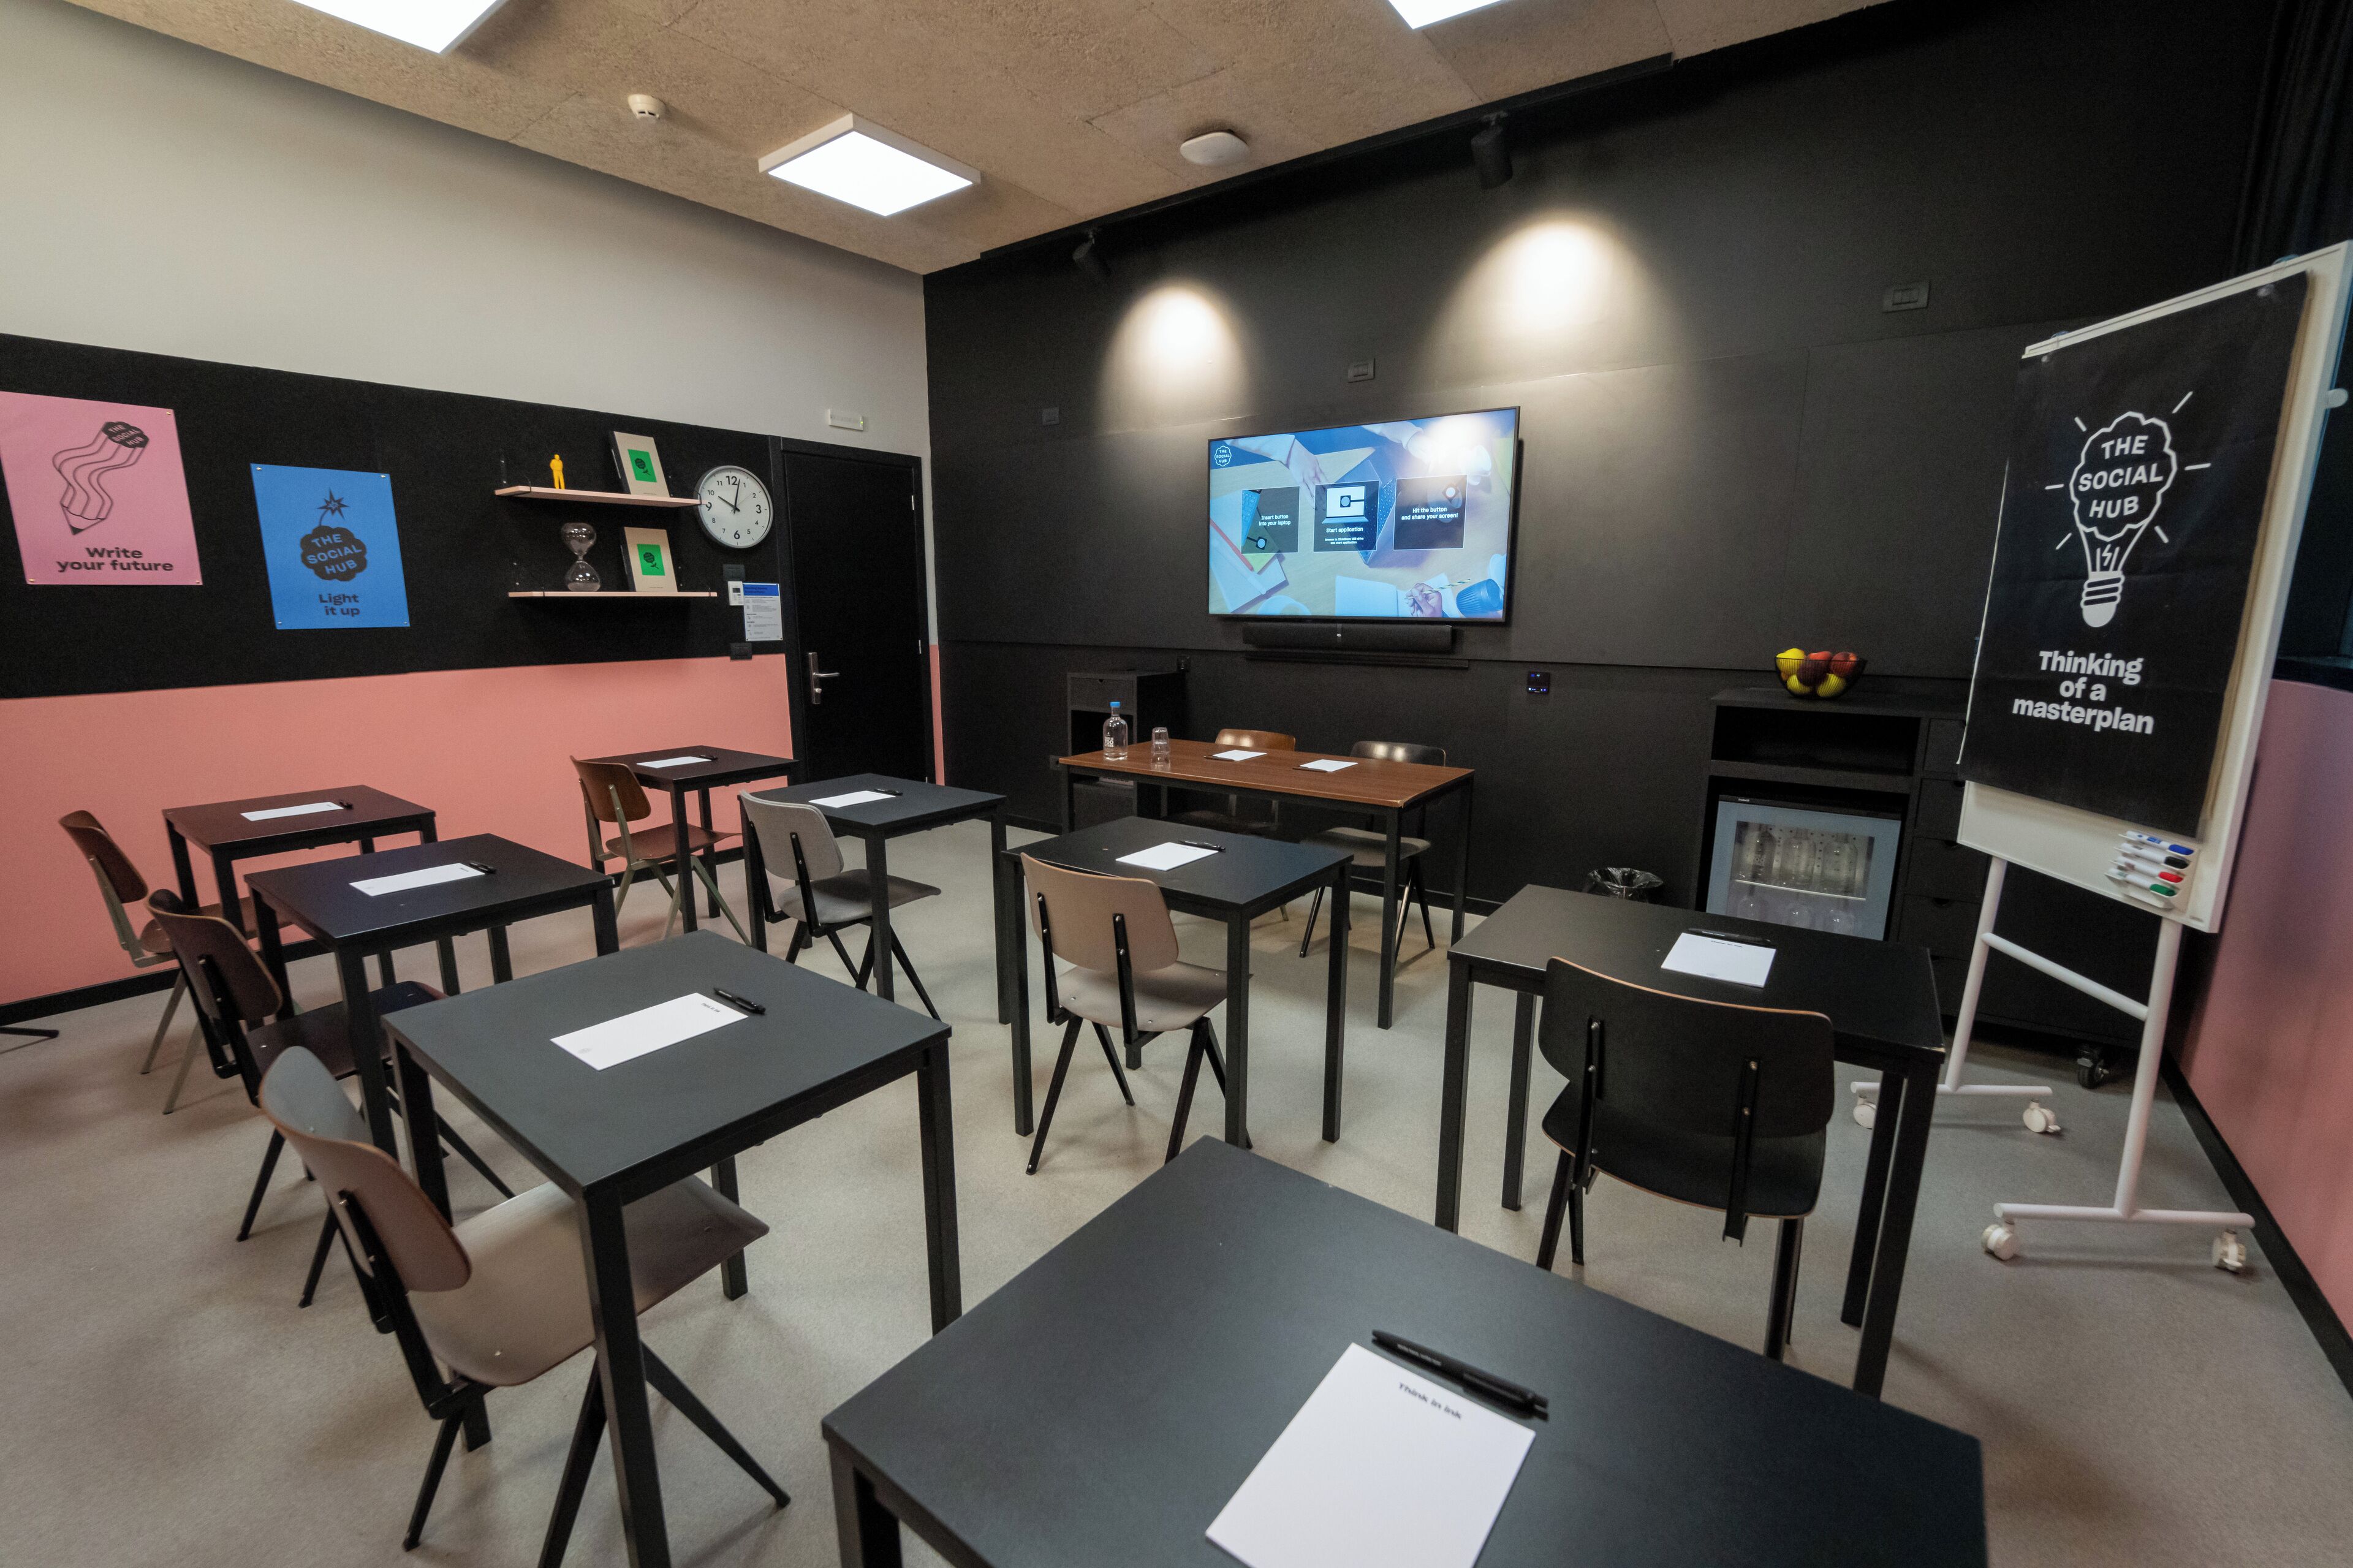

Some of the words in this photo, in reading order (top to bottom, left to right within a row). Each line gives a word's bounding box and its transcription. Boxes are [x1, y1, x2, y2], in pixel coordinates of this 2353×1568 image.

[2101, 435, 2149, 460] THE
[726, 475, 738, 485] 12
[2078, 463, 2164, 491] SOCIAL
[756, 504, 762, 513] 3
[2089, 496, 2139, 518] HUB
[311, 534, 343, 547] THE
[733, 530, 740, 540] 6
[85, 547, 143, 559] Write
[307, 545, 362, 564] SOCIAL
[56, 561, 105, 573] your
[110, 559, 174, 571] future
[325, 559, 357, 574] HUB
[319, 593, 359, 606] Light
[324, 606, 336, 615] it
[341, 607, 360, 618] up
[2039, 650, 2144, 685] Thinking
[2059, 676, 2088, 699] of
[2090, 683, 2107, 702] a
[2012, 699, 2154, 734] masterplan
[1399, 1382, 1428, 1403] Think
[1431, 1399, 1441, 1409] in
[1444, 1405, 1461, 1420] ink
